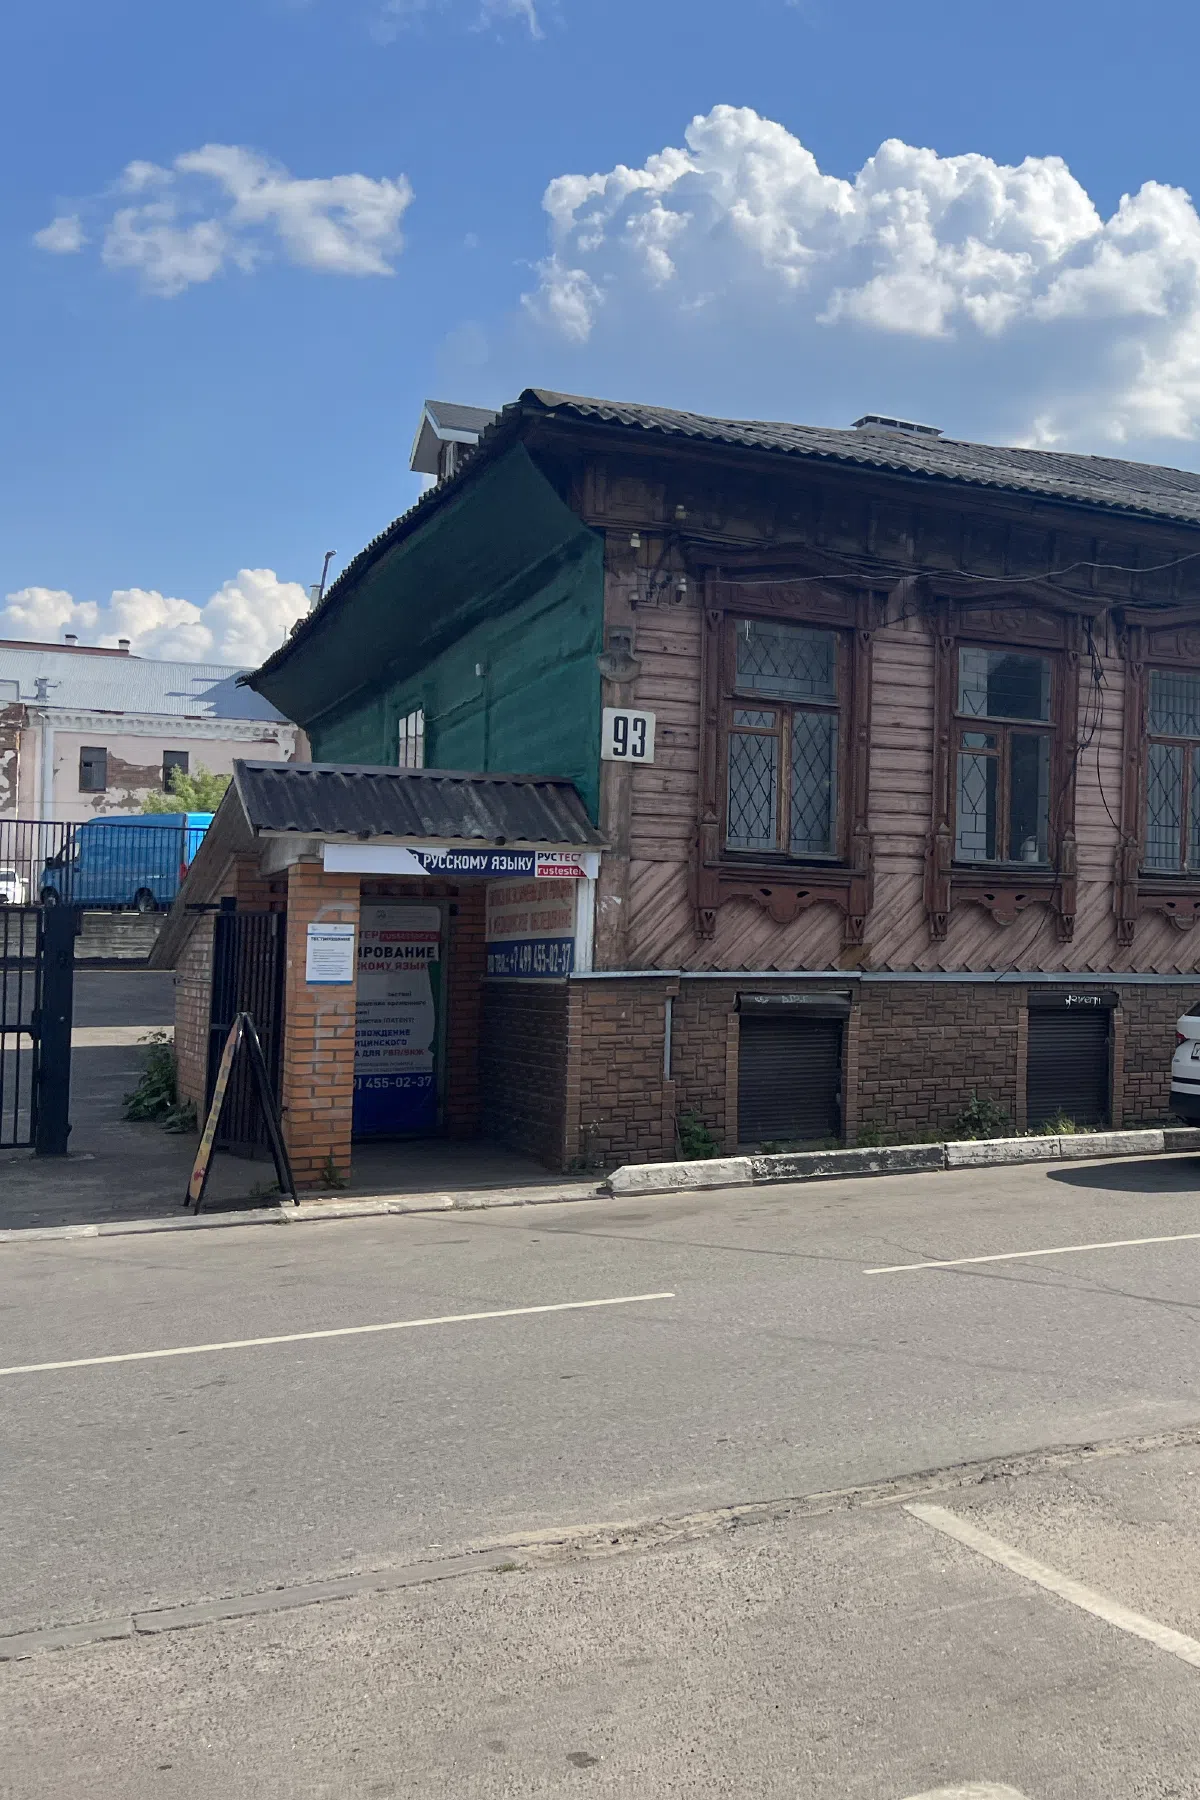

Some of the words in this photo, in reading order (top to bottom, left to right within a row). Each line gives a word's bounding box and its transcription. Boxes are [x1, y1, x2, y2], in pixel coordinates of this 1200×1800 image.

[613, 716, 646, 757] 93
[423, 855, 487, 870] РУССКОМУ
[491, 857, 533, 871] ЯЗЫКУ
[366, 1076, 432, 1089] 455-02-37
